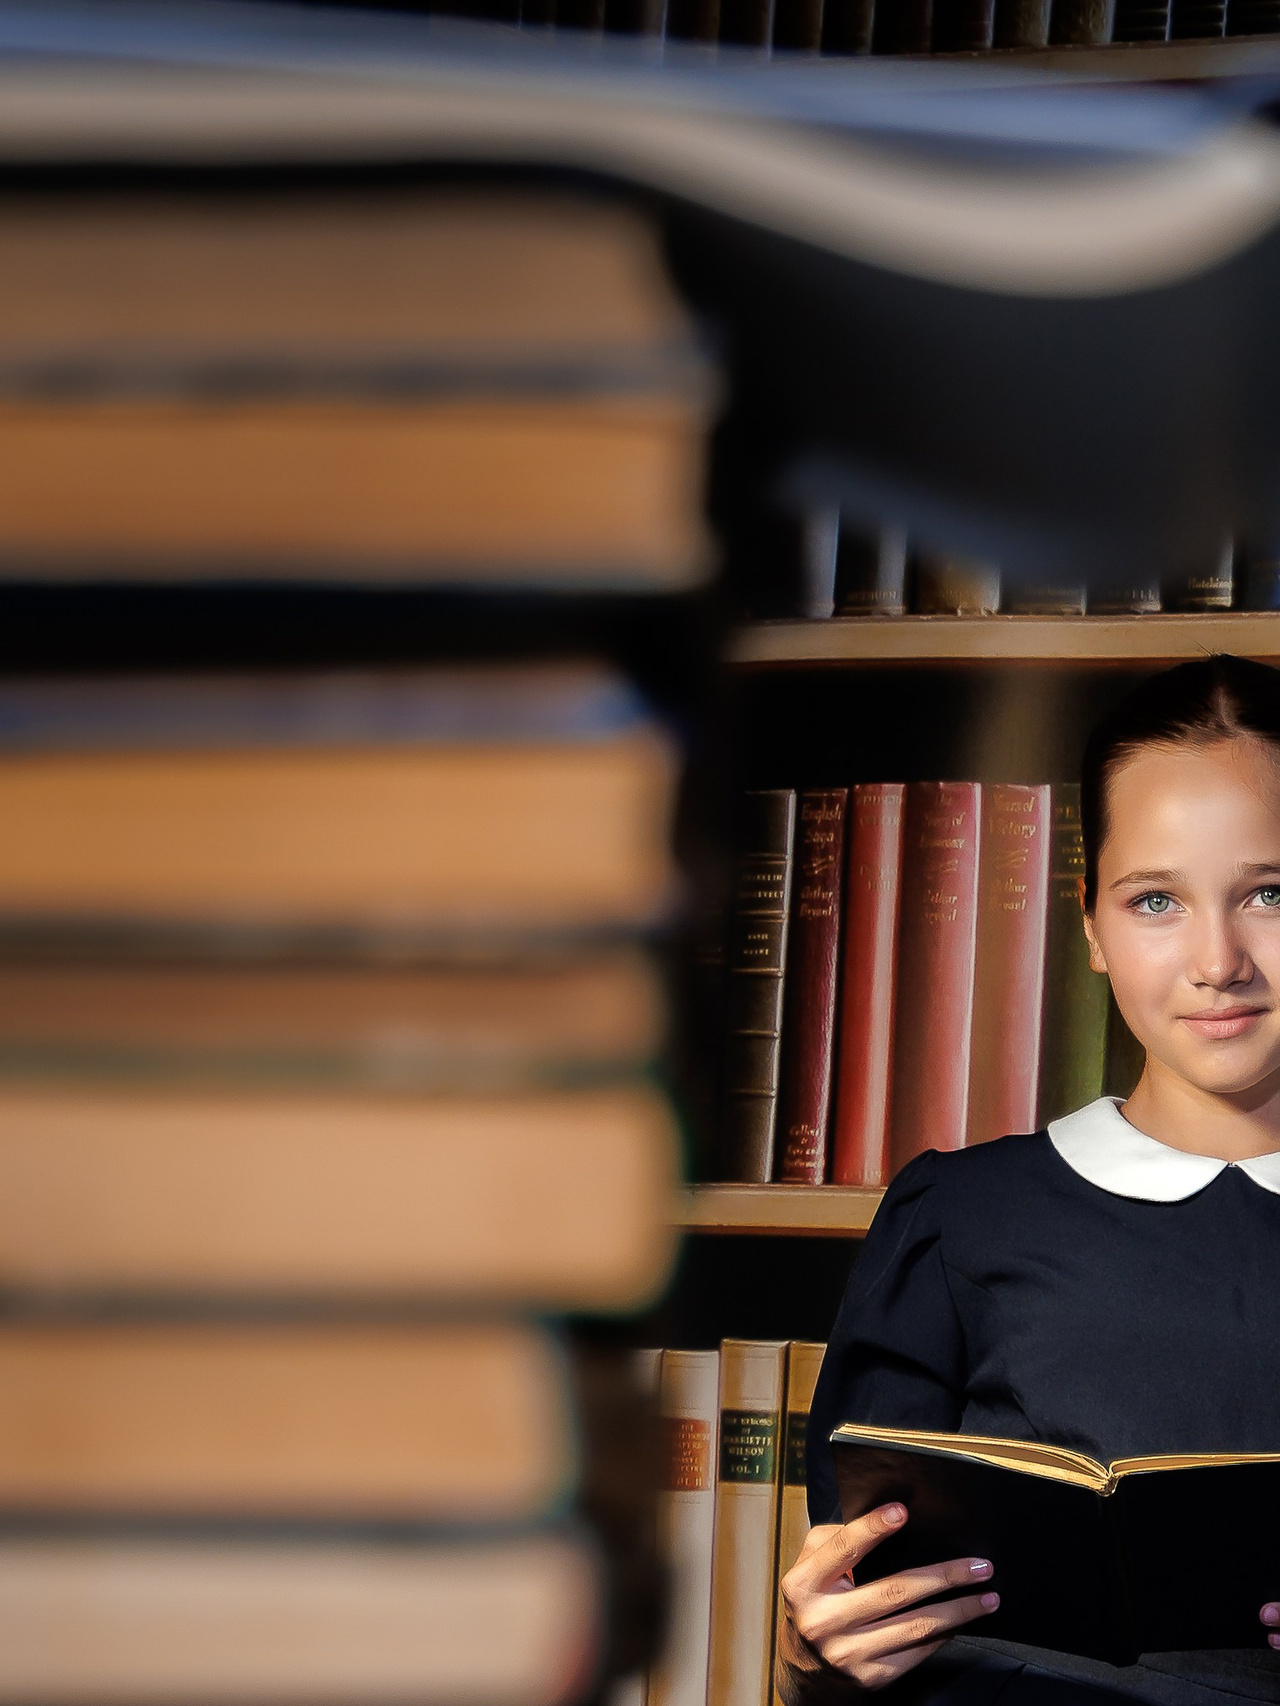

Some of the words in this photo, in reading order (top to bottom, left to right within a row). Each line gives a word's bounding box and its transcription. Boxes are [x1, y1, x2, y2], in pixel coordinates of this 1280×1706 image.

[802, 803, 841, 825] English
[989, 817, 1036, 839] Vtory
[728, 1447, 764, 1456] WILSON
